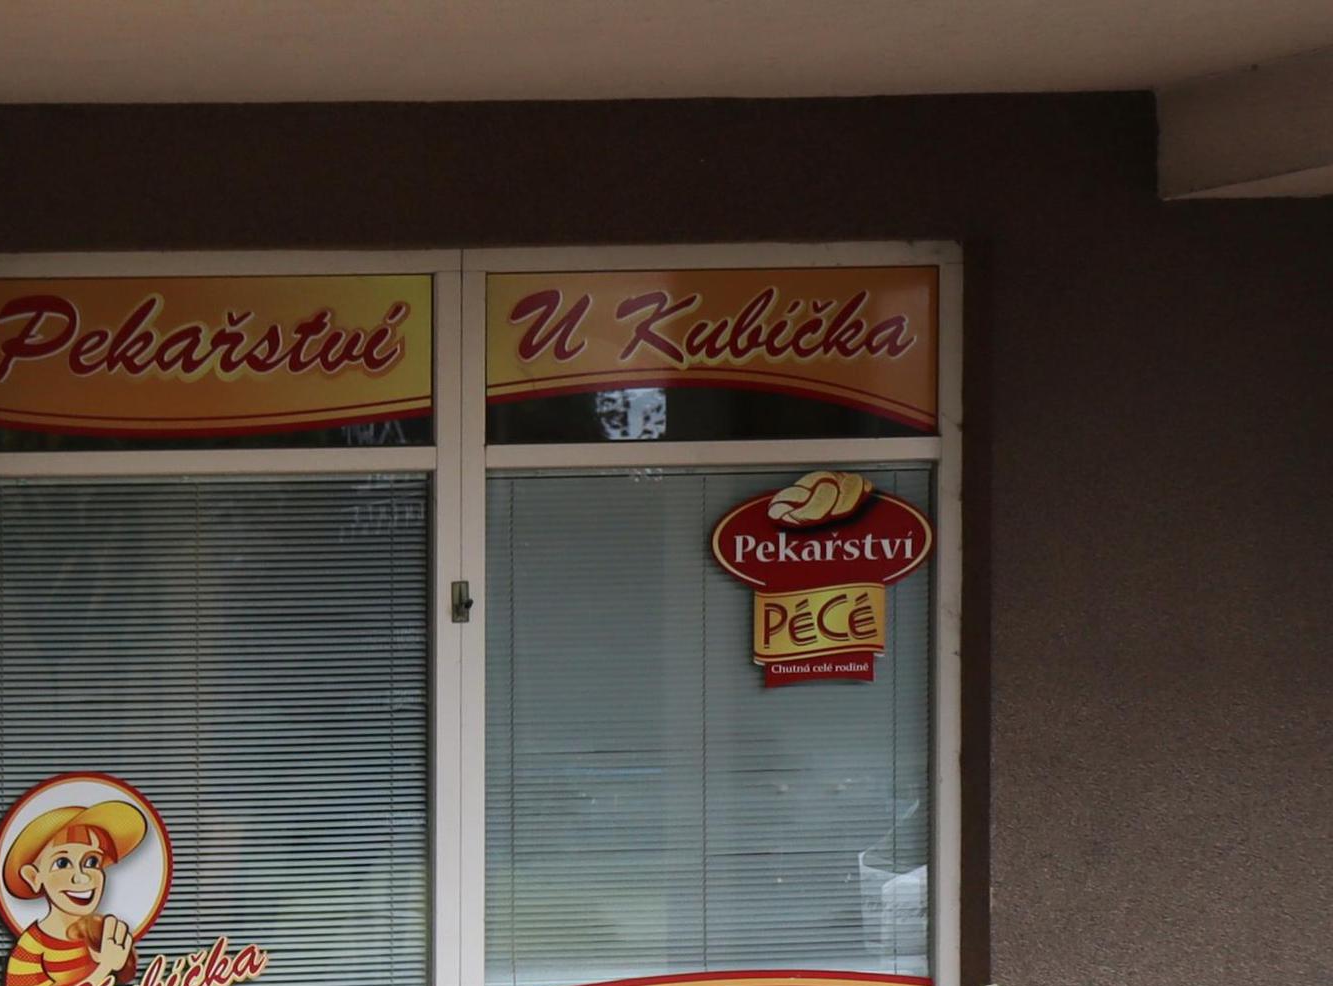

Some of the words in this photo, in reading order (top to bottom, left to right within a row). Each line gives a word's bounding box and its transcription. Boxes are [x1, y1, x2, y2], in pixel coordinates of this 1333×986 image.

[508, 289, 590, 363] U
[615, 287, 918, 366] Kubíčka
[734, 531, 915, 564] Pekařství
[771, 663, 811, 674] Chutná
[813, 662, 833, 673] celé
